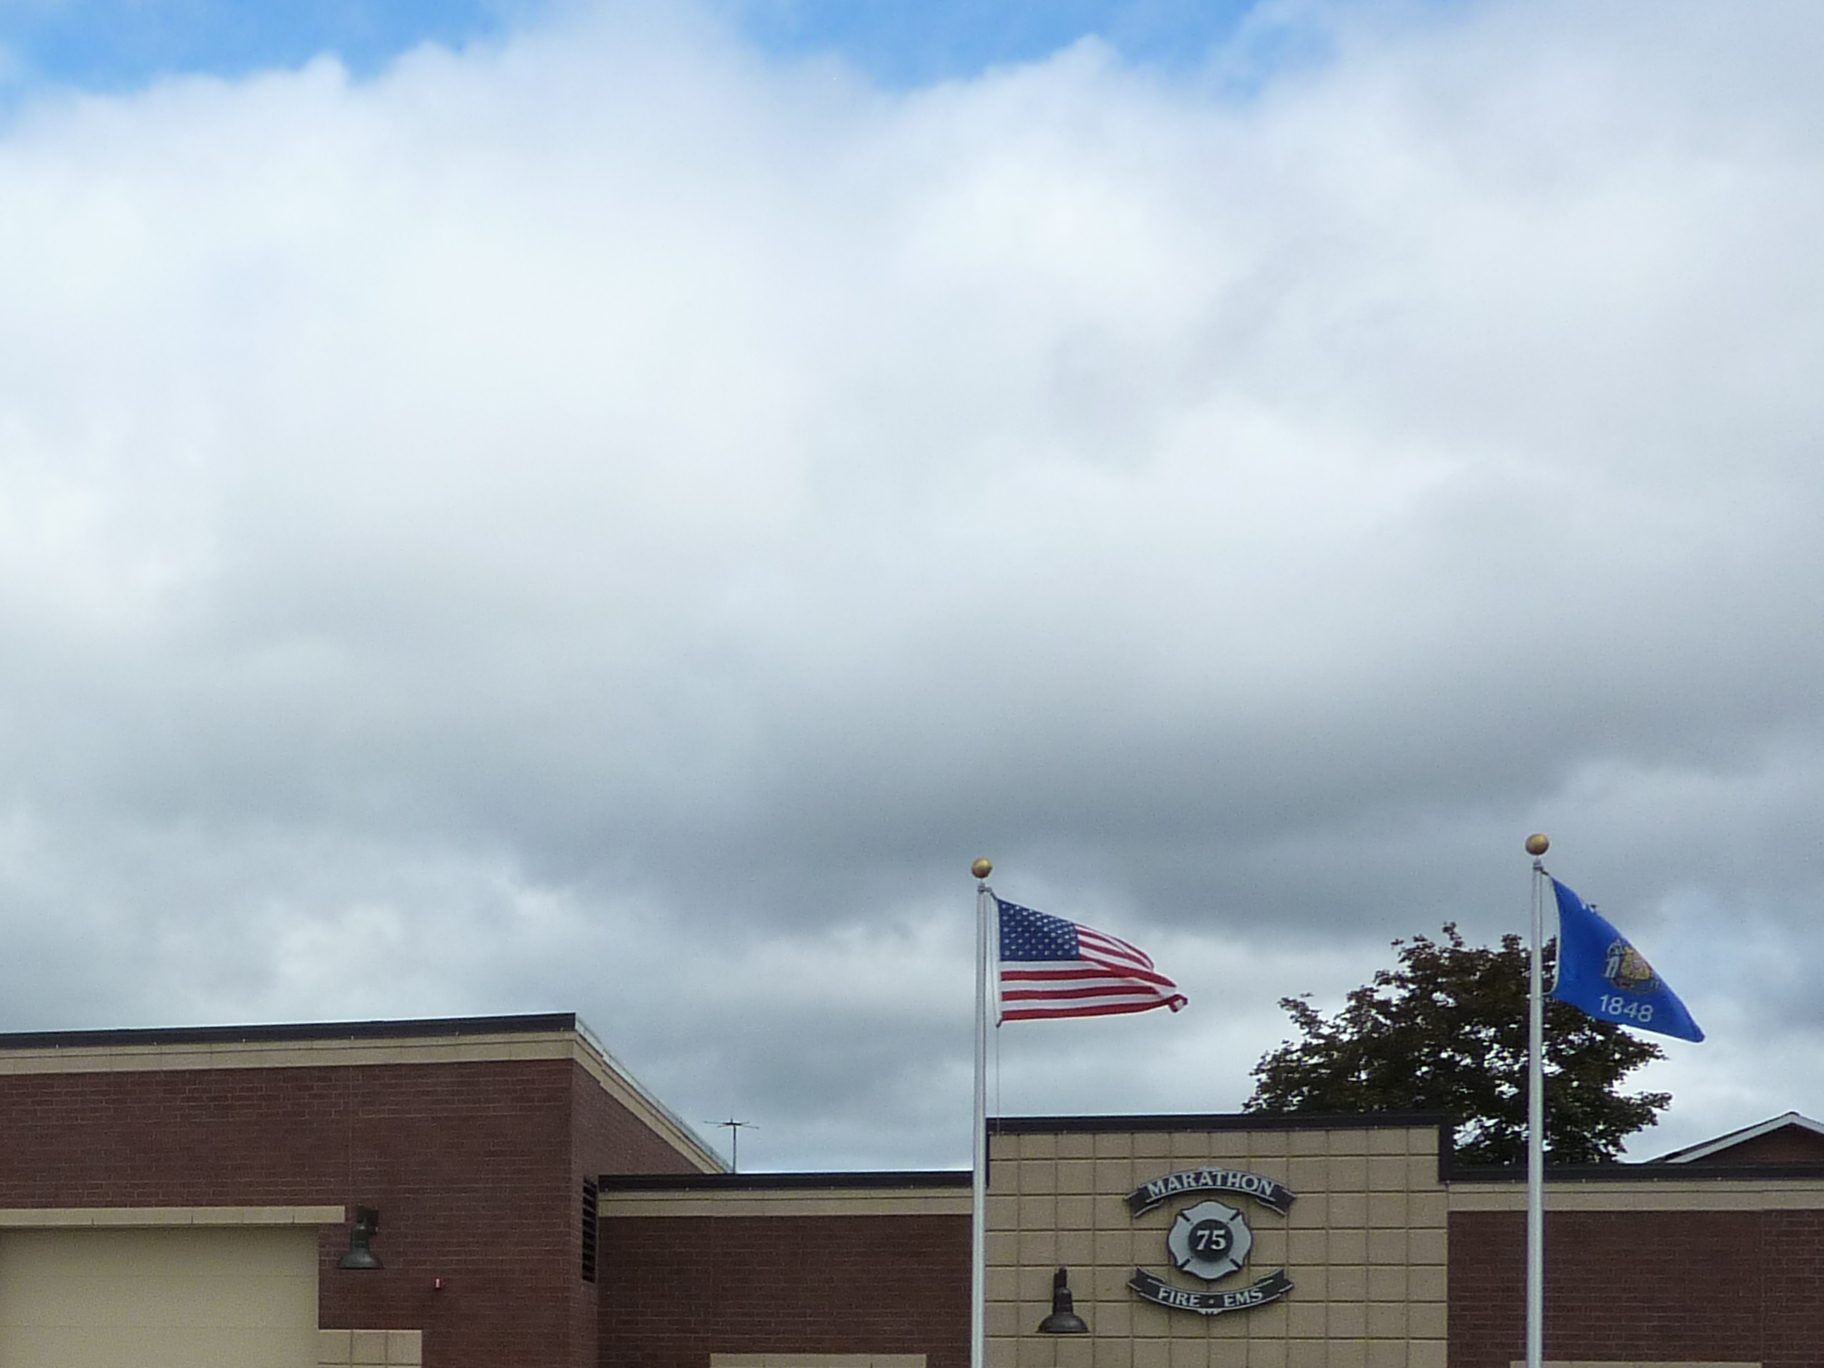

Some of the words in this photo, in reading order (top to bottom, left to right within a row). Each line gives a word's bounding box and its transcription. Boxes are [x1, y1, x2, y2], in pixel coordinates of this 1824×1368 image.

[1599, 994, 1654, 1022] 1848
[1147, 1171, 1274, 1198] MARATHON
[1196, 1229, 1226, 1250] 75
[1157, 1287, 1201, 1307] FIRE
[1224, 1288, 1263, 1307] EMS
